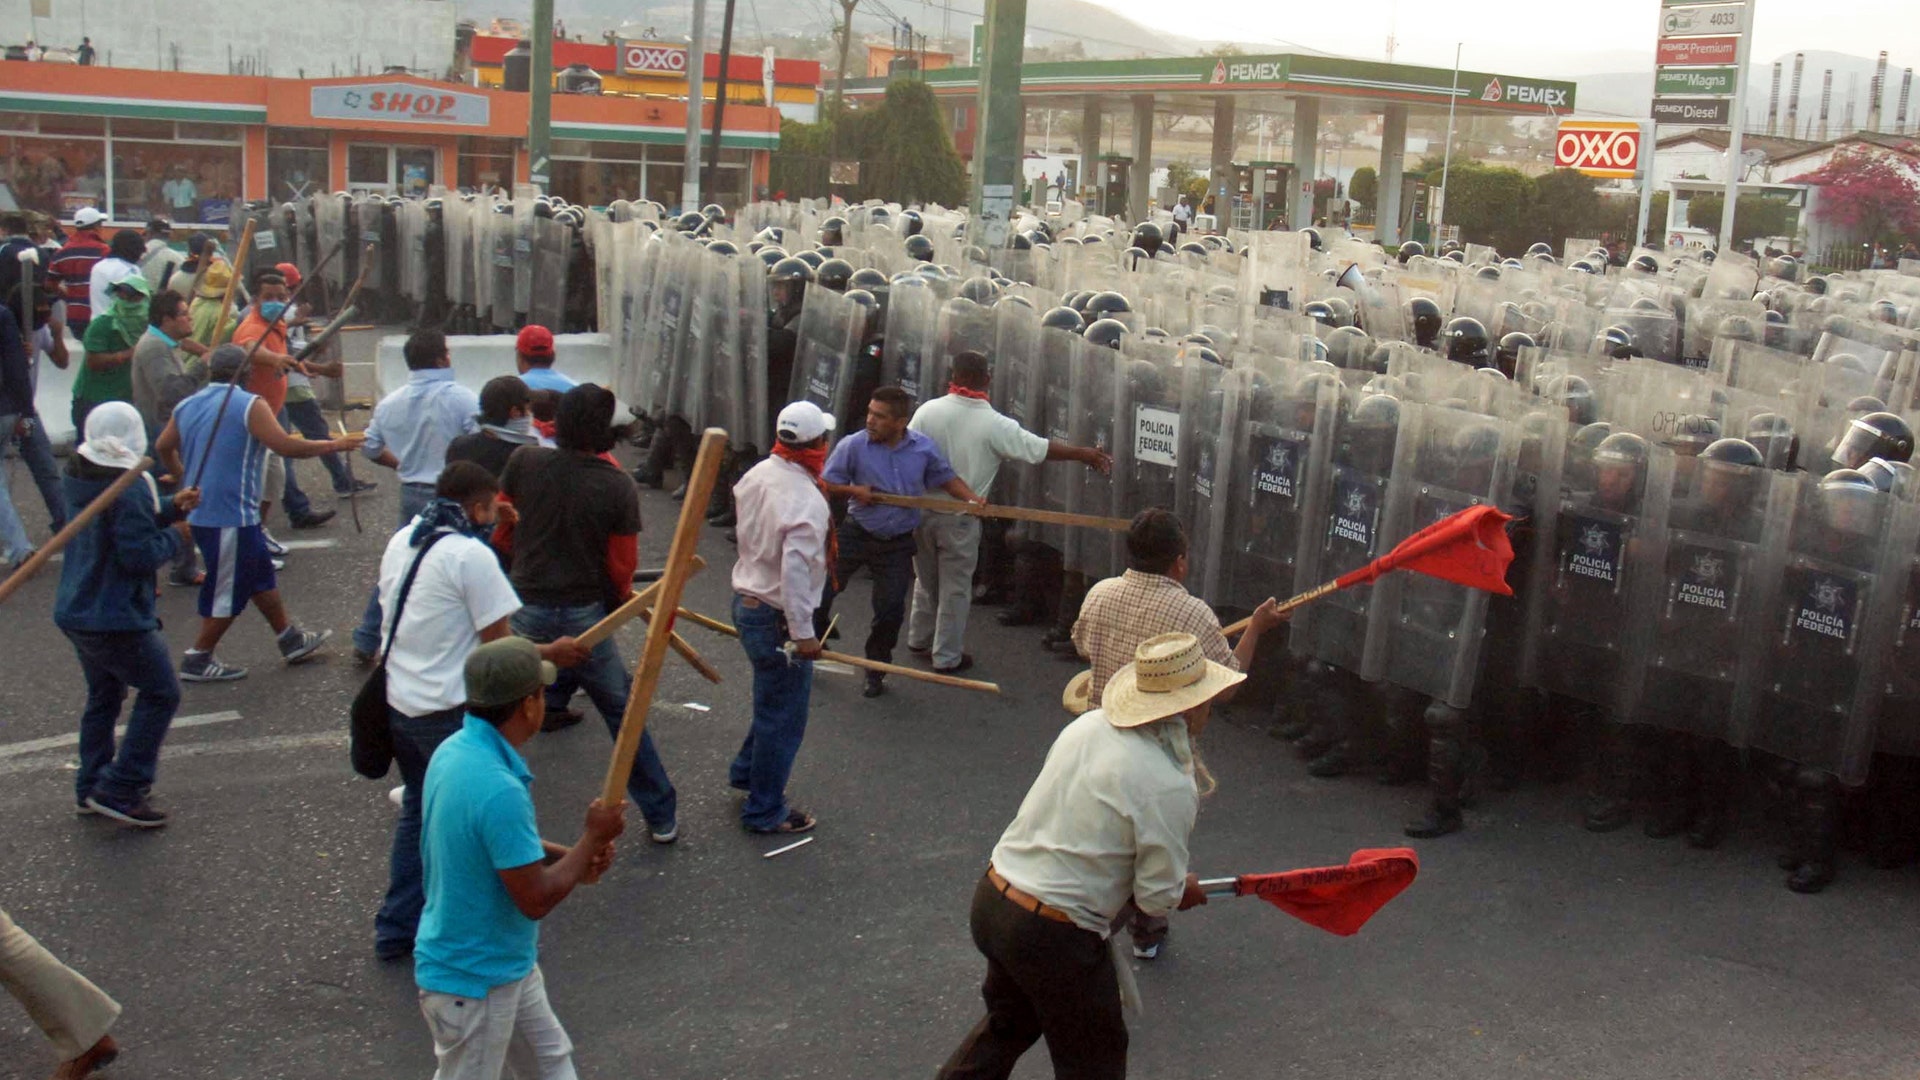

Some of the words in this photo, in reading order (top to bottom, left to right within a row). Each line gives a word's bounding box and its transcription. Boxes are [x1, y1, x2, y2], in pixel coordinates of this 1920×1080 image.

[1710, 13, 1735, 26] 4033
[1661, 43, 1690, 51] PEMEX
[1690, 42, 1733, 54] Premium
[627, 47, 685, 70] OXXO
[1230, 63, 1280, 80] PEMEX
[1660, 73, 1688, 81] PEMEX
[1688, 73, 1726, 90] Magna
[368, 91, 457, 114] SHOP
[1507, 85, 1567, 106] PEMEX
[1655, 104, 1684, 113] PEMEX
[1684, 105, 1719, 118] Diesel
[1558, 131, 1636, 168] OXXO
[1139, 436, 1174, 454] FEDERAL
[1258, 481, 1293, 497] FEDERAL
[1334, 526, 1368, 544] FEDERAL
[1569, 563, 1614, 581] FEDERAL
[1678, 592, 1728, 609] FEDERAL
[1796, 617, 1846, 639] FEDERAL
